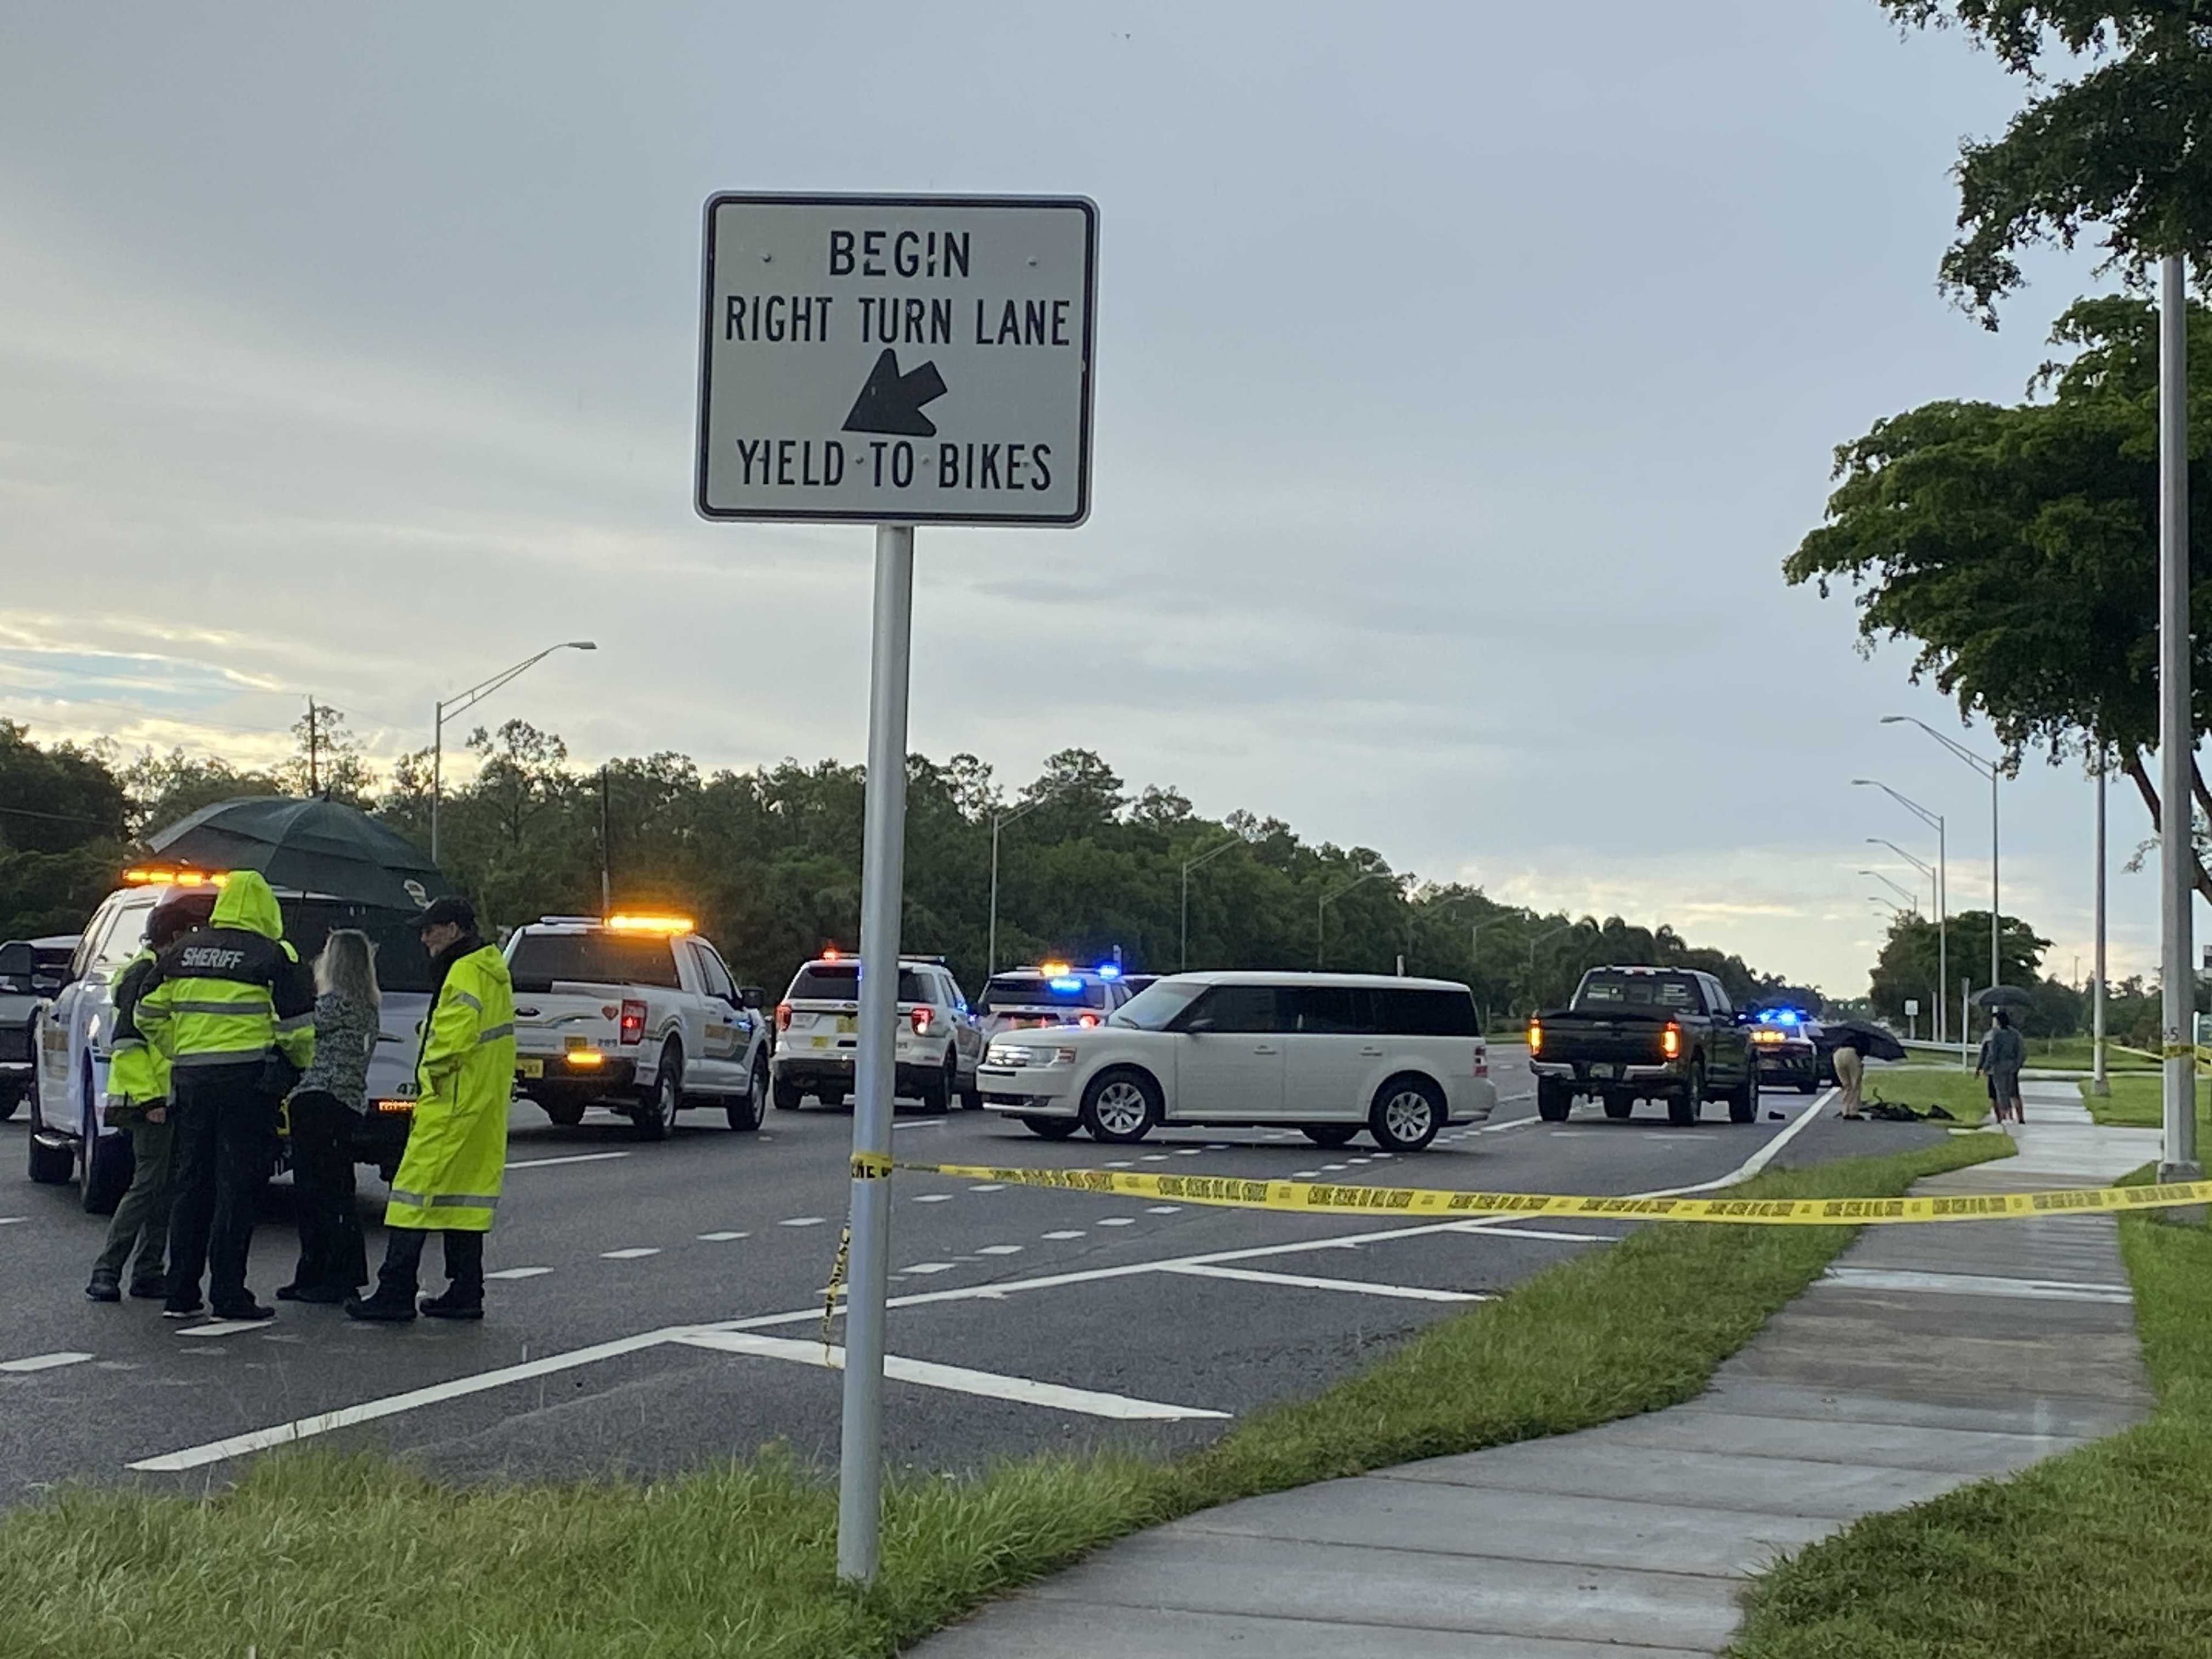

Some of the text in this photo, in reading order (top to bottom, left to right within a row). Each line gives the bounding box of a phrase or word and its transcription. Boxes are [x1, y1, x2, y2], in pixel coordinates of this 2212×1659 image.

[830, 230, 970, 278] BEGIN
[726, 296, 1070, 346] RIGHT TURN LANE
[737, 439, 1052, 491] YIELD TO BIKES
[181, 947, 245, 969] SHERIFF
